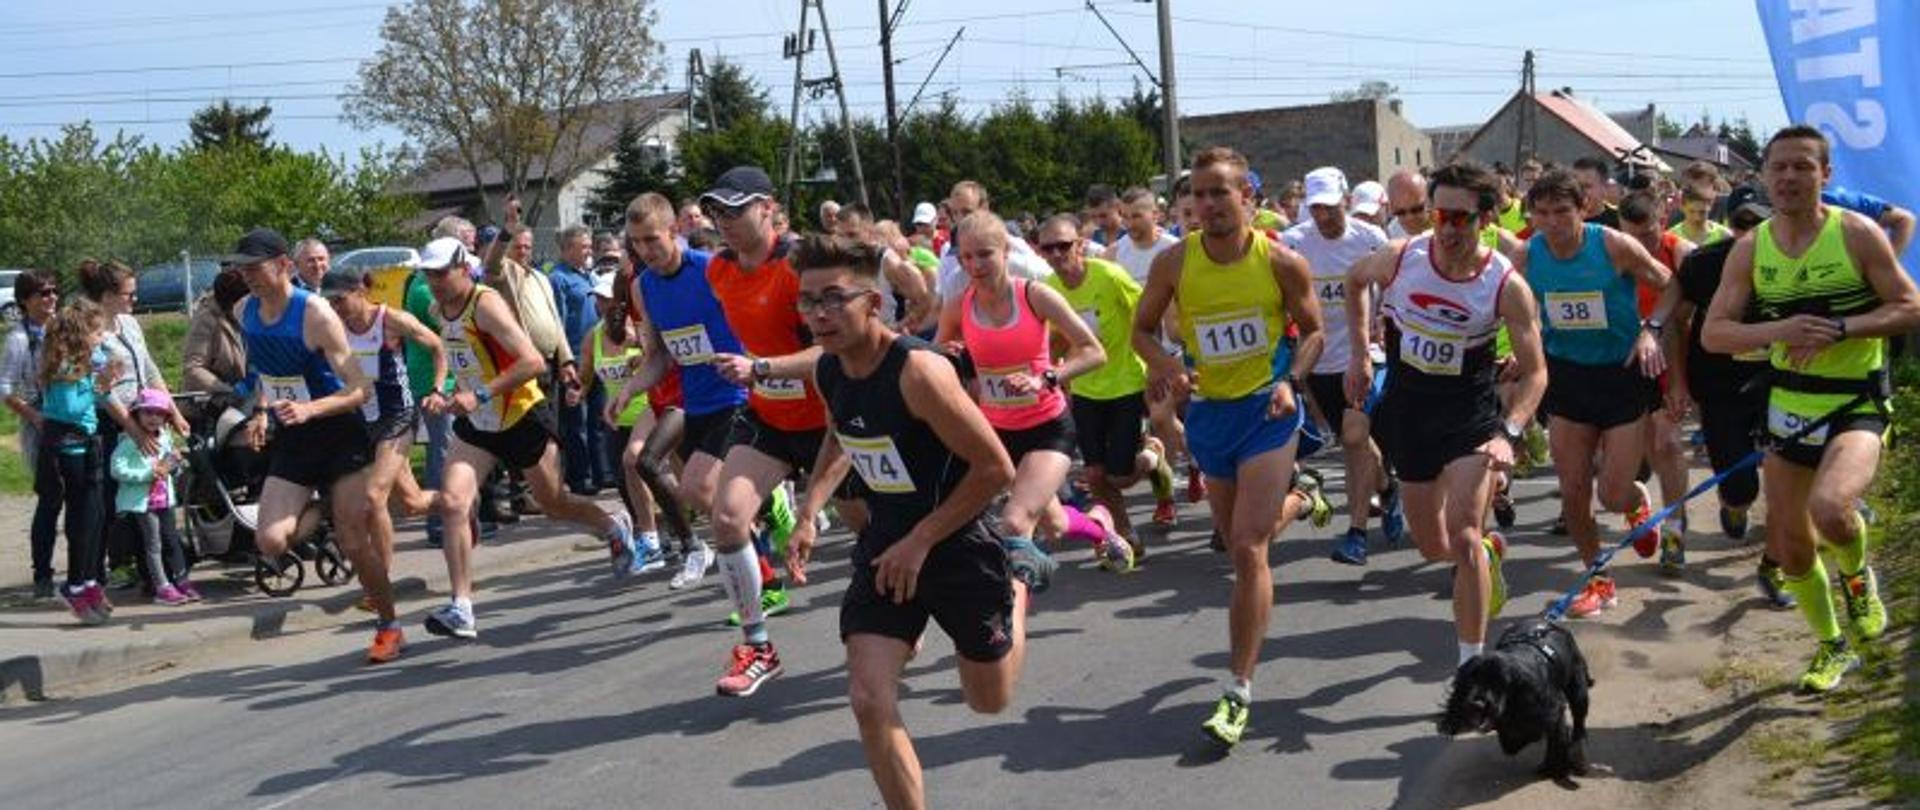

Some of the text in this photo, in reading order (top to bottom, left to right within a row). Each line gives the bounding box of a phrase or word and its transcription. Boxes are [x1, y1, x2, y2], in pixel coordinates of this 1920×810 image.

[1561, 302, 1590, 320] 38
[671, 334, 702, 356] 237
[1205, 322, 1257, 352] 110
[1408, 335, 1455, 364] 109
[271, 384, 298, 401] 73
[851, 452, 899, 480] 174
